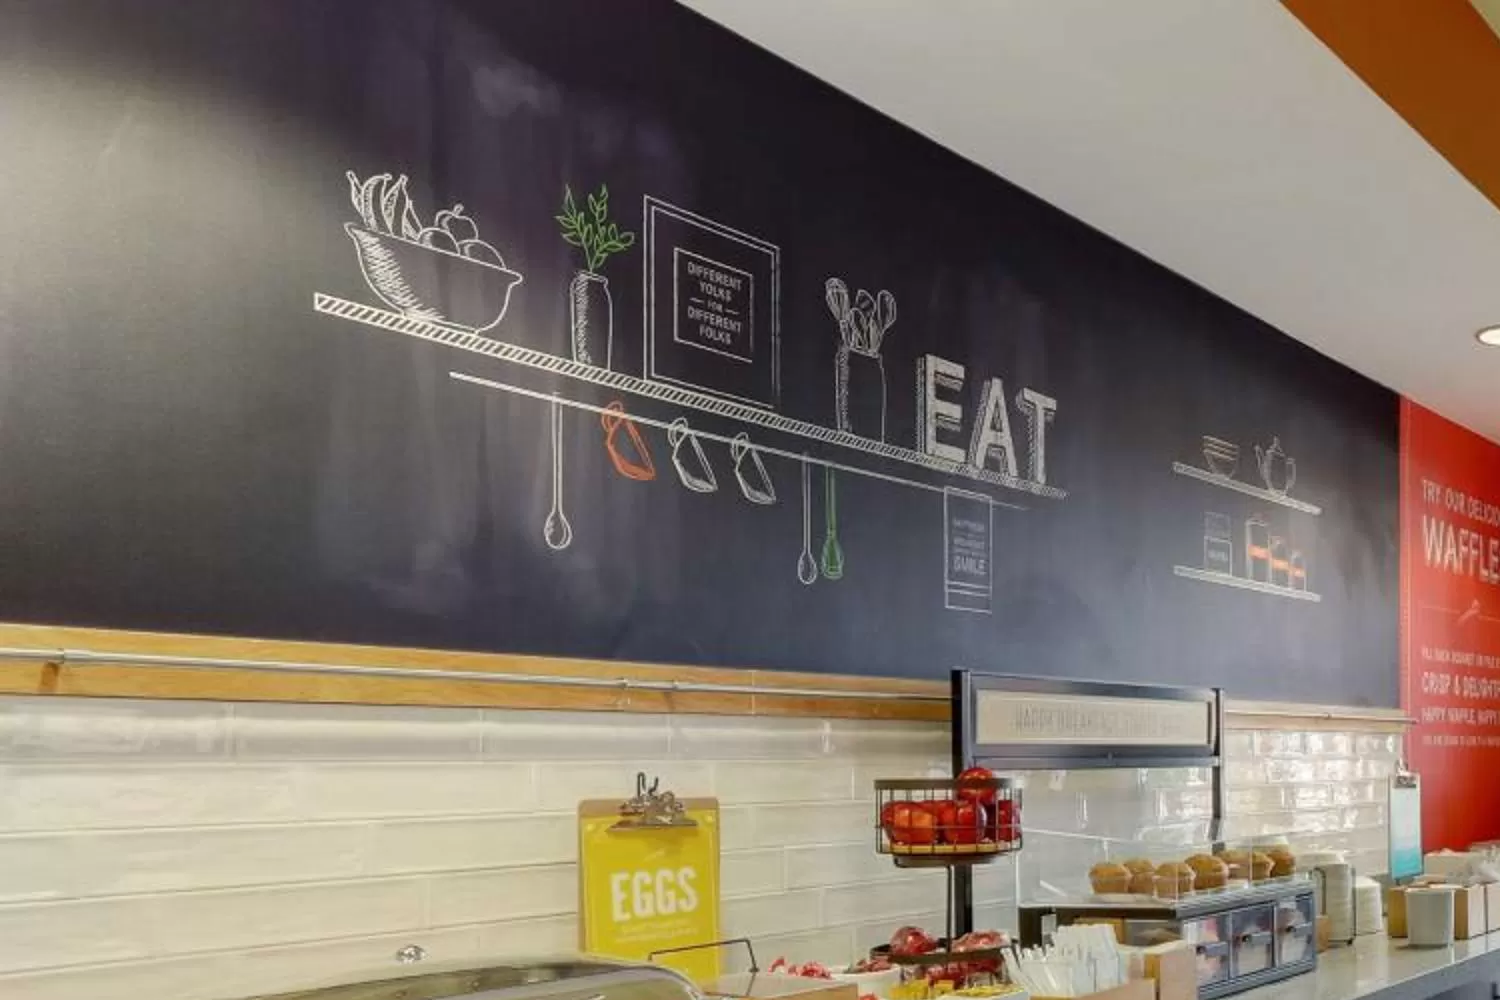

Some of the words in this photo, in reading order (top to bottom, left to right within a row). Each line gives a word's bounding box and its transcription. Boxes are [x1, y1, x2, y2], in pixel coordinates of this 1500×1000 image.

[687, 261, 742, 290] DIFFERENT
[700, 281, 732, 302] YOLKS
[687, 306, 742, 333] DIFFERENT
[707, 300, 723, 313] FOR
[699, 325, 732, 345] FOLKS
[916, 353, 1057, 485] EAT
[1422, 478, 1441, 504] TRY
[1445, 487, 1465, 515] OUR
[610, 866, 699, 923] EGGS
